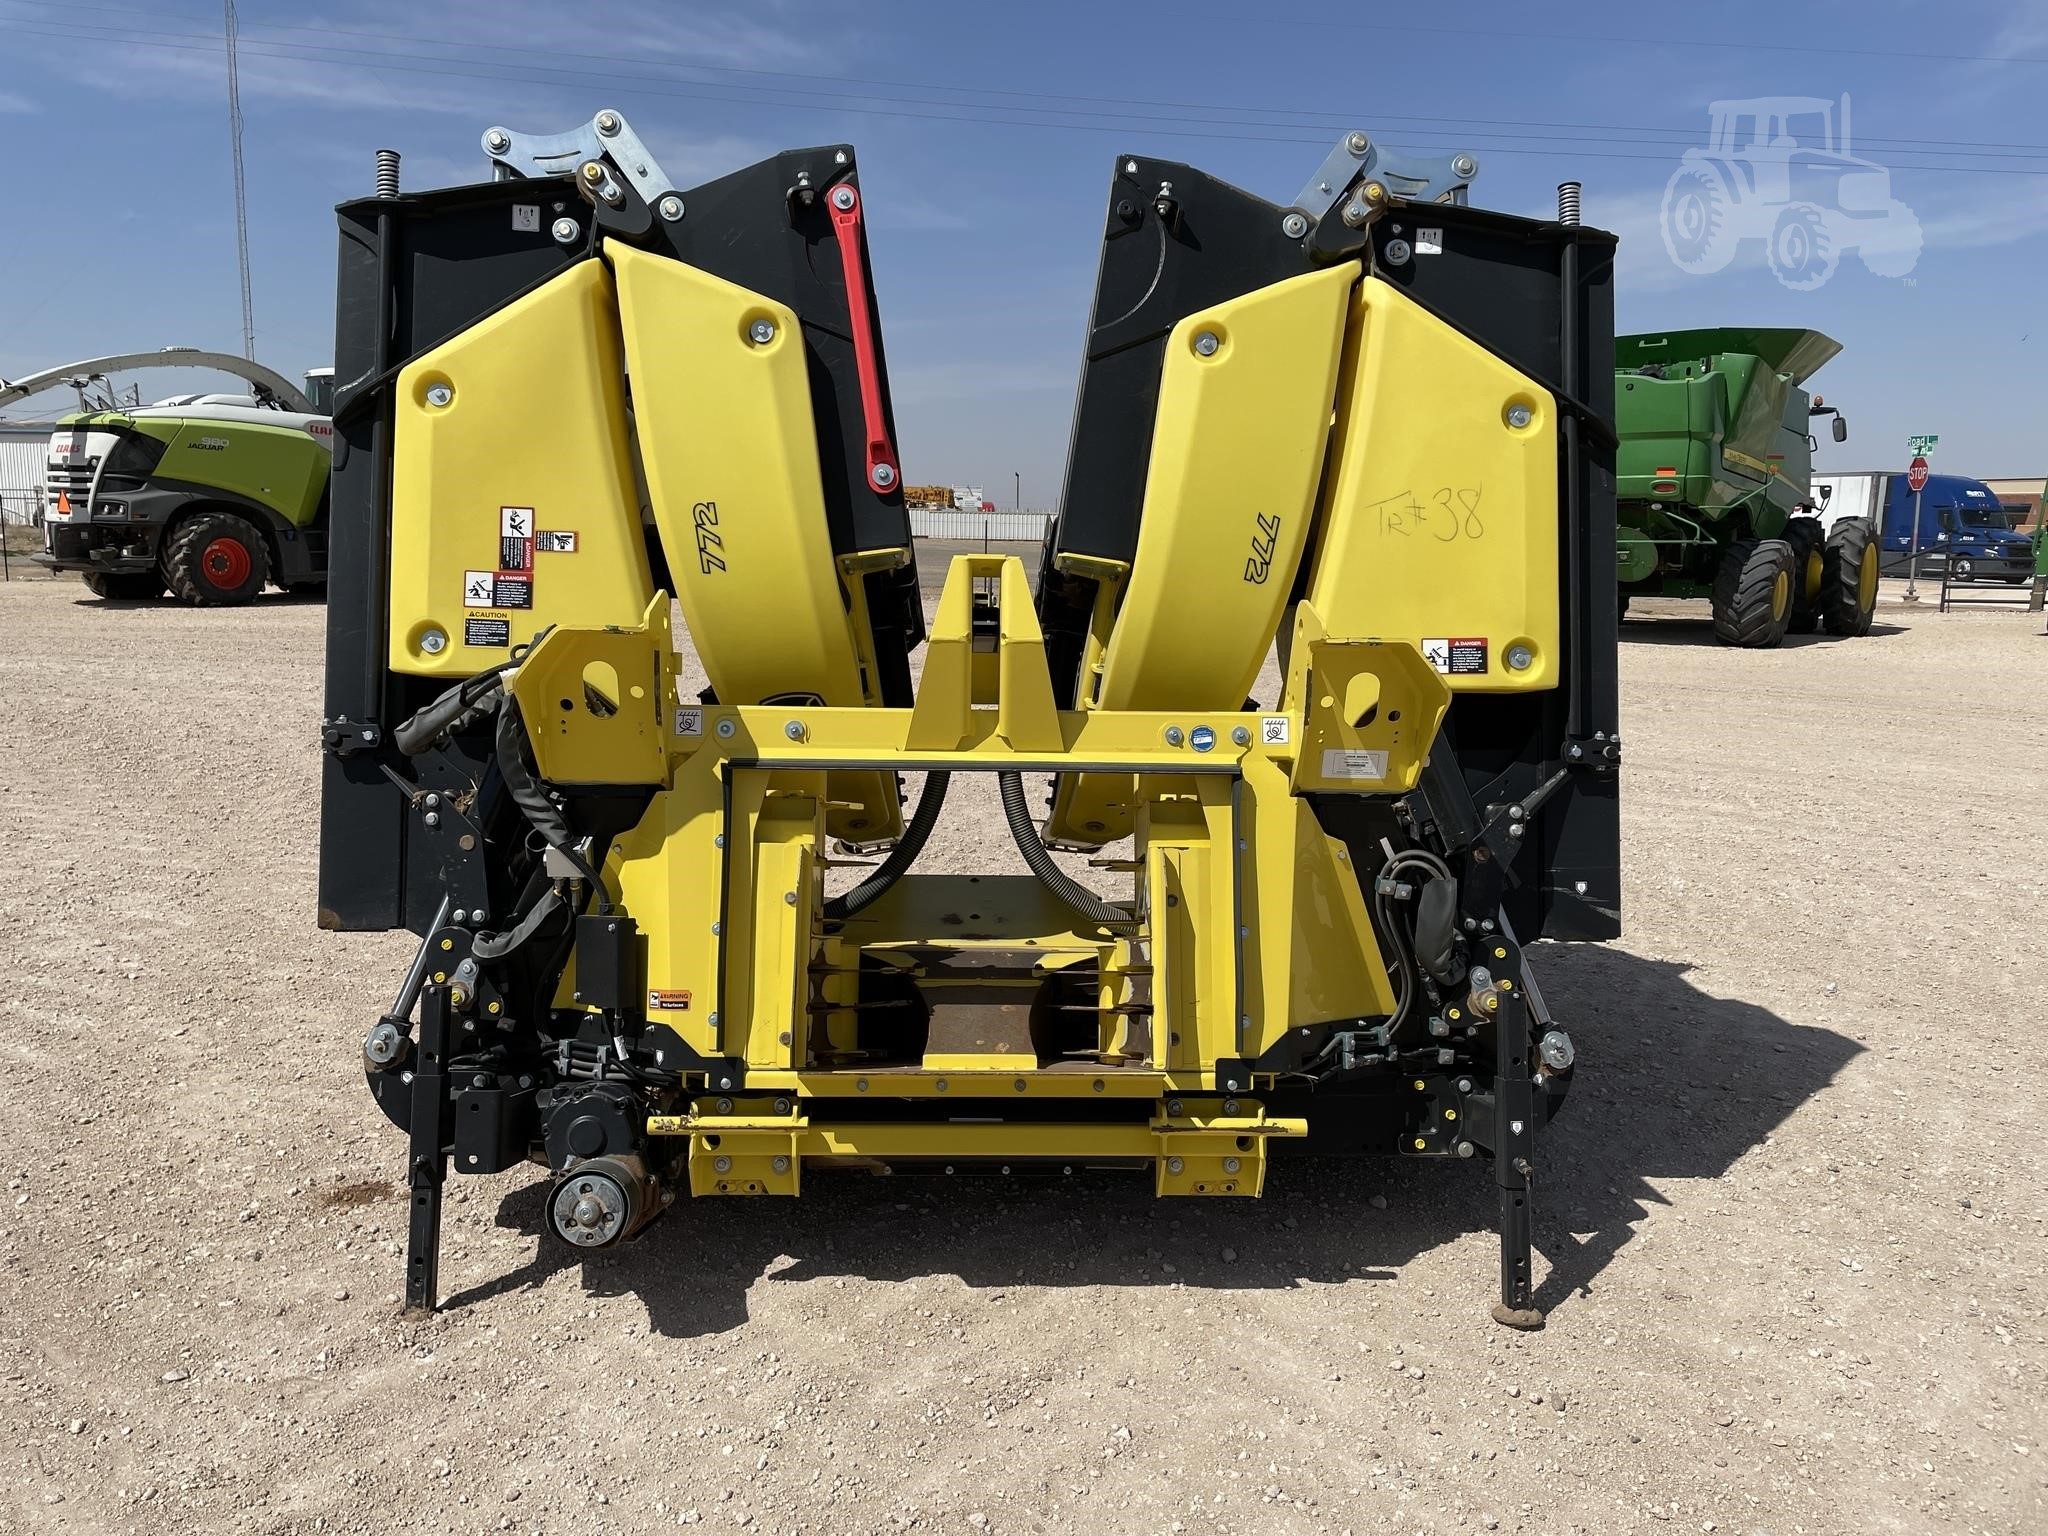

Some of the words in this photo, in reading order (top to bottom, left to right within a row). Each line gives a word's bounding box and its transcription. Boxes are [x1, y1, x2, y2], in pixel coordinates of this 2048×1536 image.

[187, 442, 225, 451] JAGUAR
[1906, 436, 1925, 447] Road
[55, 444, 81, 453] CLAAS
[1910, 467, 1927, 480] STOP
[693, 502, 727, 574] 772
[1244, 512, 1281, 584] 772
